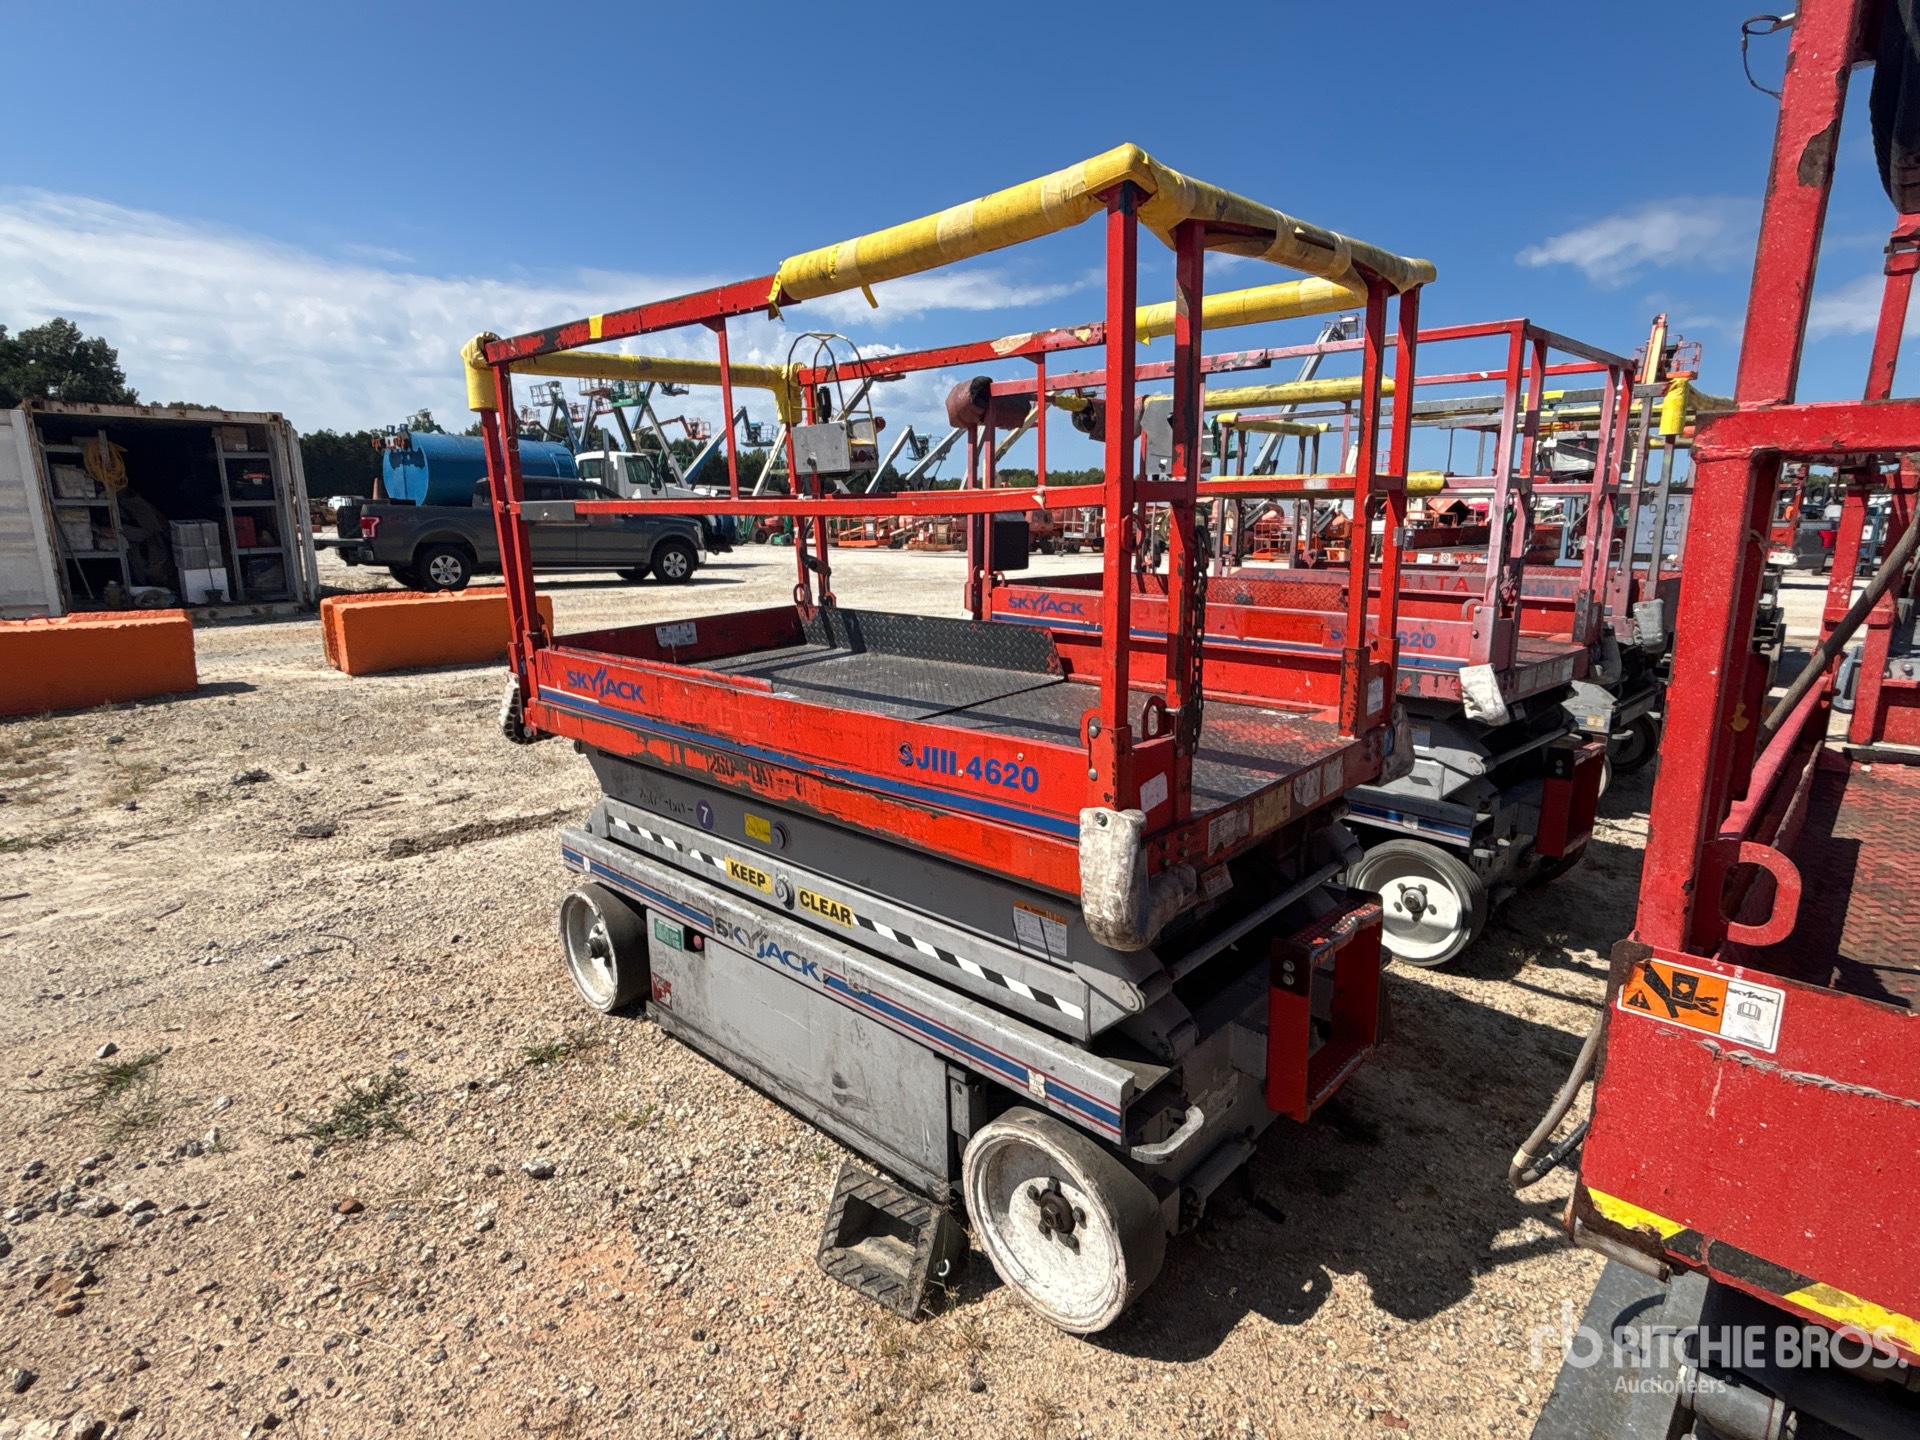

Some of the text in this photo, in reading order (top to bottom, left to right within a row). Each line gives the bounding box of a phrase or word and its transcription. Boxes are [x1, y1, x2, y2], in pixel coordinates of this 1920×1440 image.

[1647, 530, 1681, 541] OLY
[1008, 592, 1085, 616] SKYJACK
[566, 666, 646, 704] SKYJACK
[965, 755, 1040, 793] 4620
[701, 805, 709, 824] 7
[730, 861, 851, 925] KEEP CLEAR
